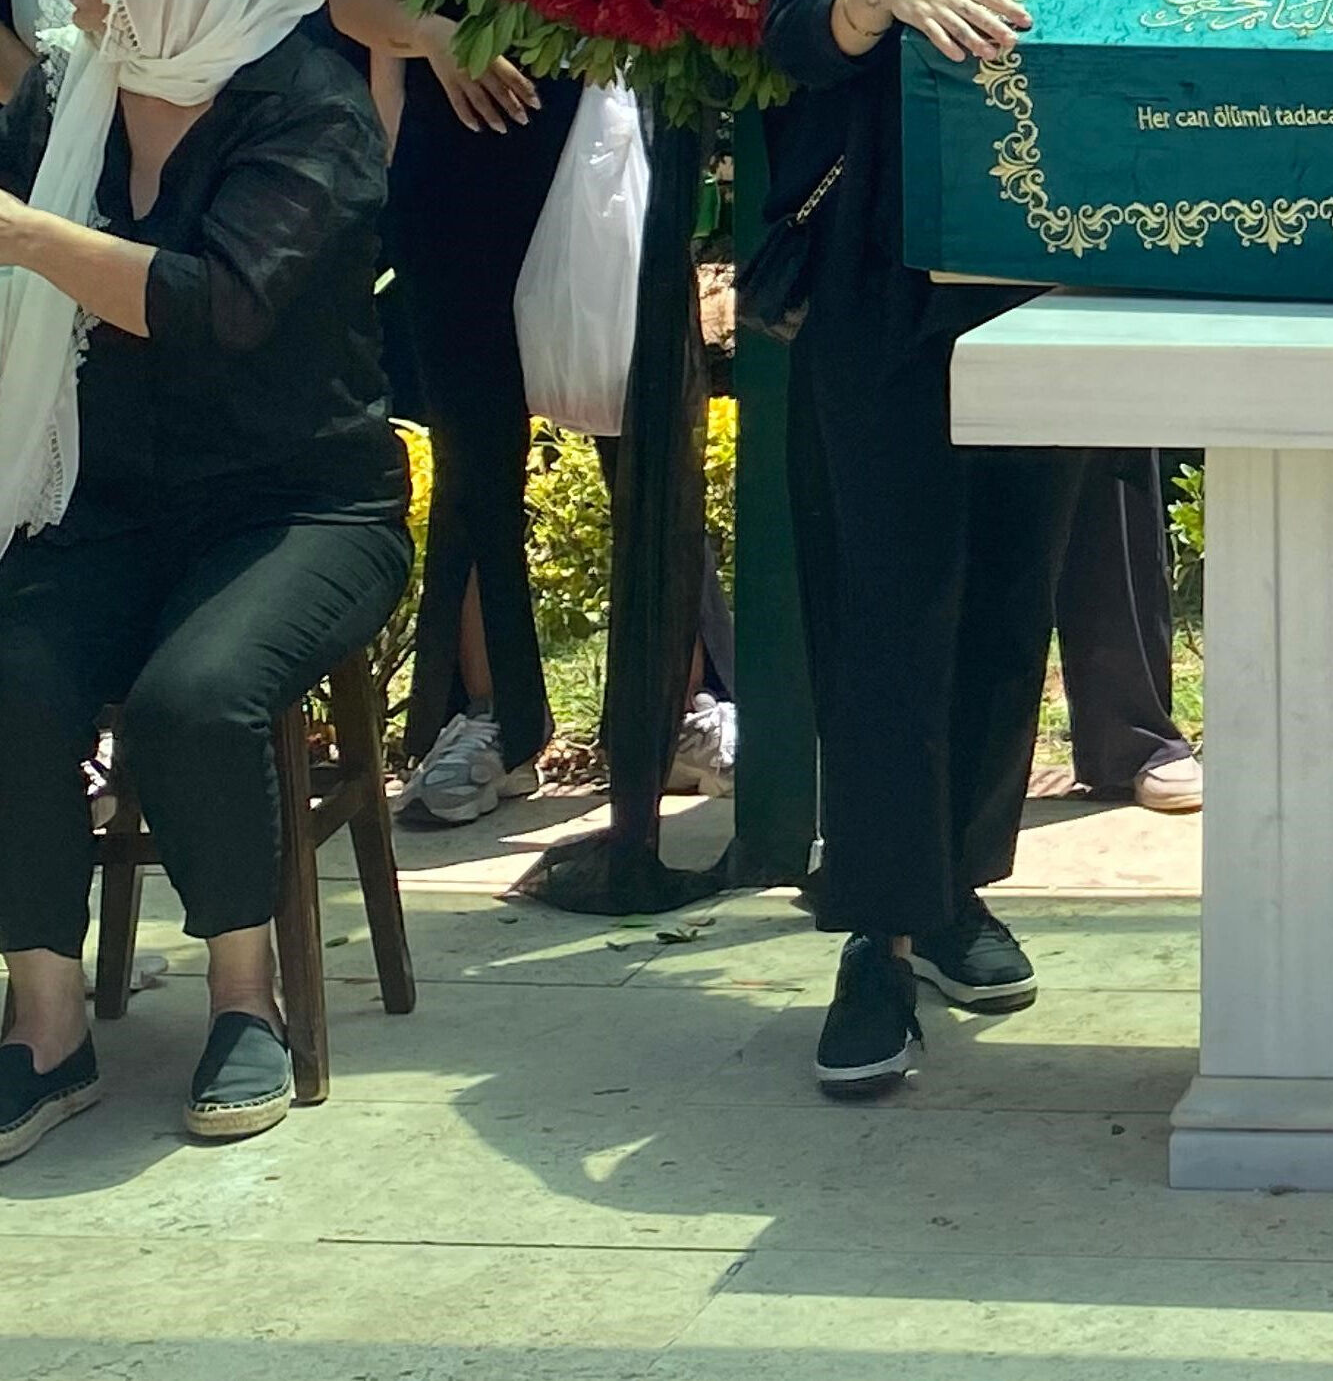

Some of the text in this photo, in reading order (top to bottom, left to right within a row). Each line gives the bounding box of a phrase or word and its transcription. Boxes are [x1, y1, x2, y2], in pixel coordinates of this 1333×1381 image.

[1137, 106, 1171, 130] Her
[1175, 110, 1211, 128] can
[1213, 104, 1272, 128] ölümü
